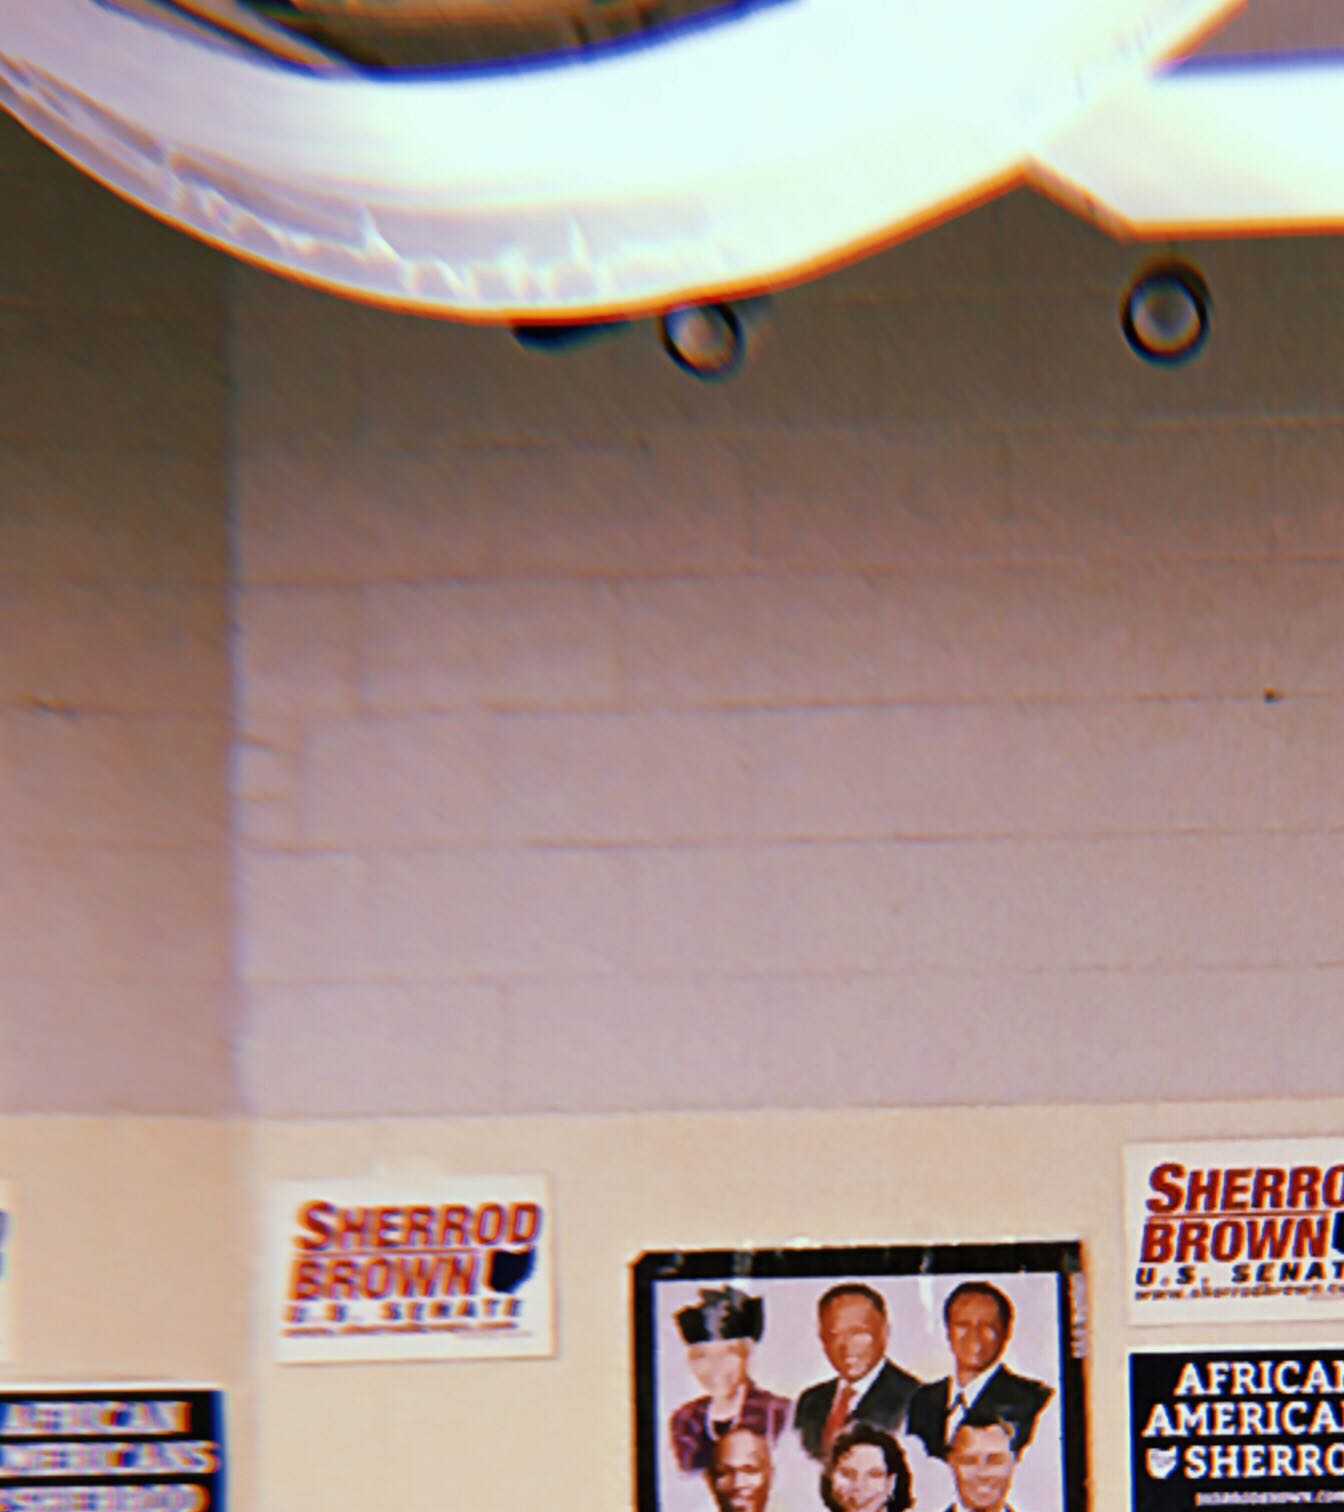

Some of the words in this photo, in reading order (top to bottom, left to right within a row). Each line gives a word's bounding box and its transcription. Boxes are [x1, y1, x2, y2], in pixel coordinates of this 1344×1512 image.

[293, 1199, 541, 1250] SHERROD
[1139, 1217, 1330, 1263] BROWN
[287, 1256, 480, 1301] BROWN
[0, 1440, 221, 1477] MERICANS
